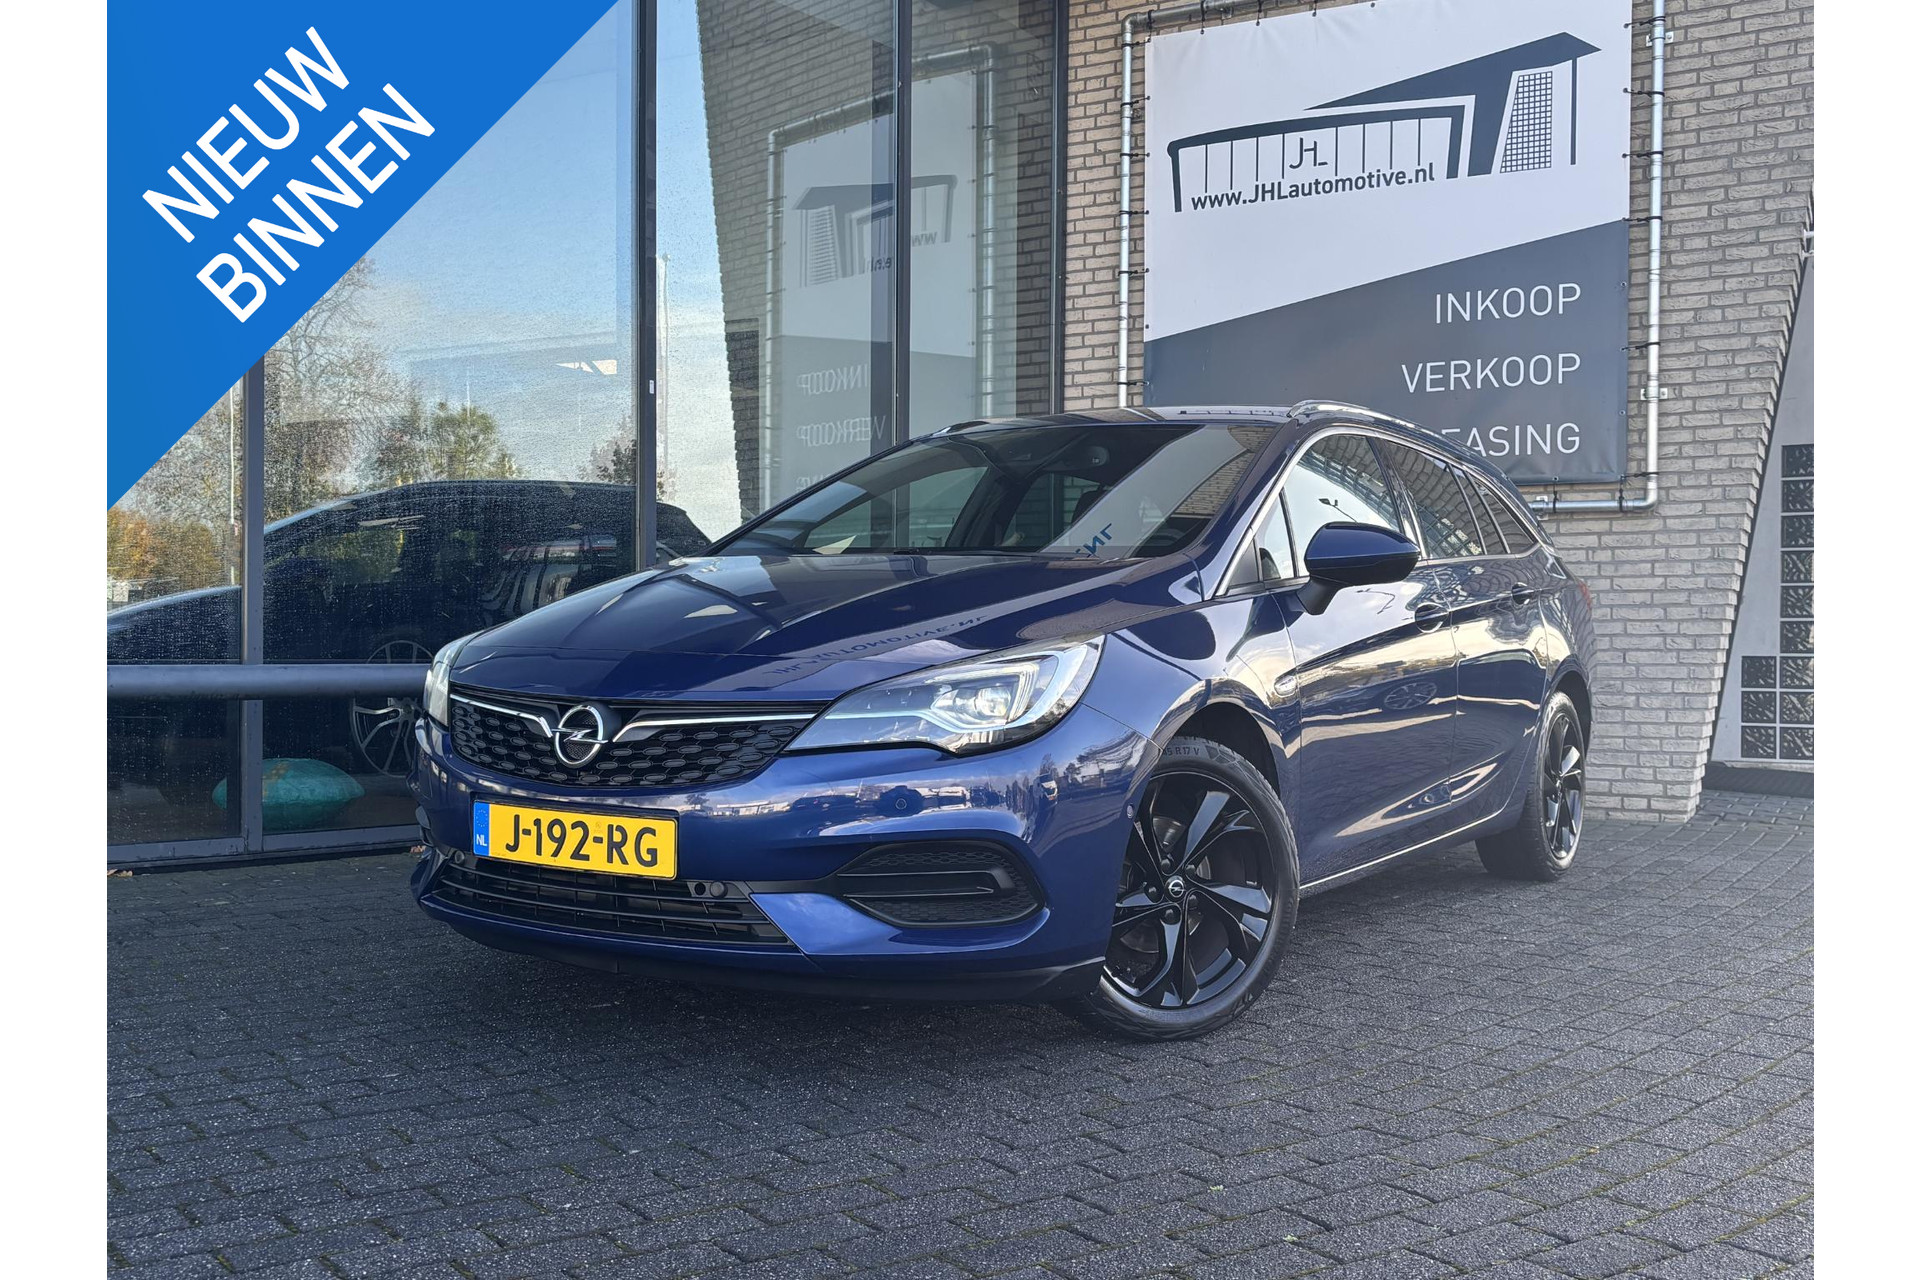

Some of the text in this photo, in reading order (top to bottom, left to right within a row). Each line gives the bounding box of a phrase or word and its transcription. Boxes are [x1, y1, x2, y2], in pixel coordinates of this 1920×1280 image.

[1288, 137, 1328, 169] JHL
[1190, 161, 1435, 211] www.JHLautomotive.nl
[1435, 282, 1581, 324] INKOOP
[1401, 352, 1581, 394] VERKOOP
[1441, 422, 1581, 458] ASING
[476, 833, 487, 847] NL
[505, 813, 658, 868] J-192-RG
